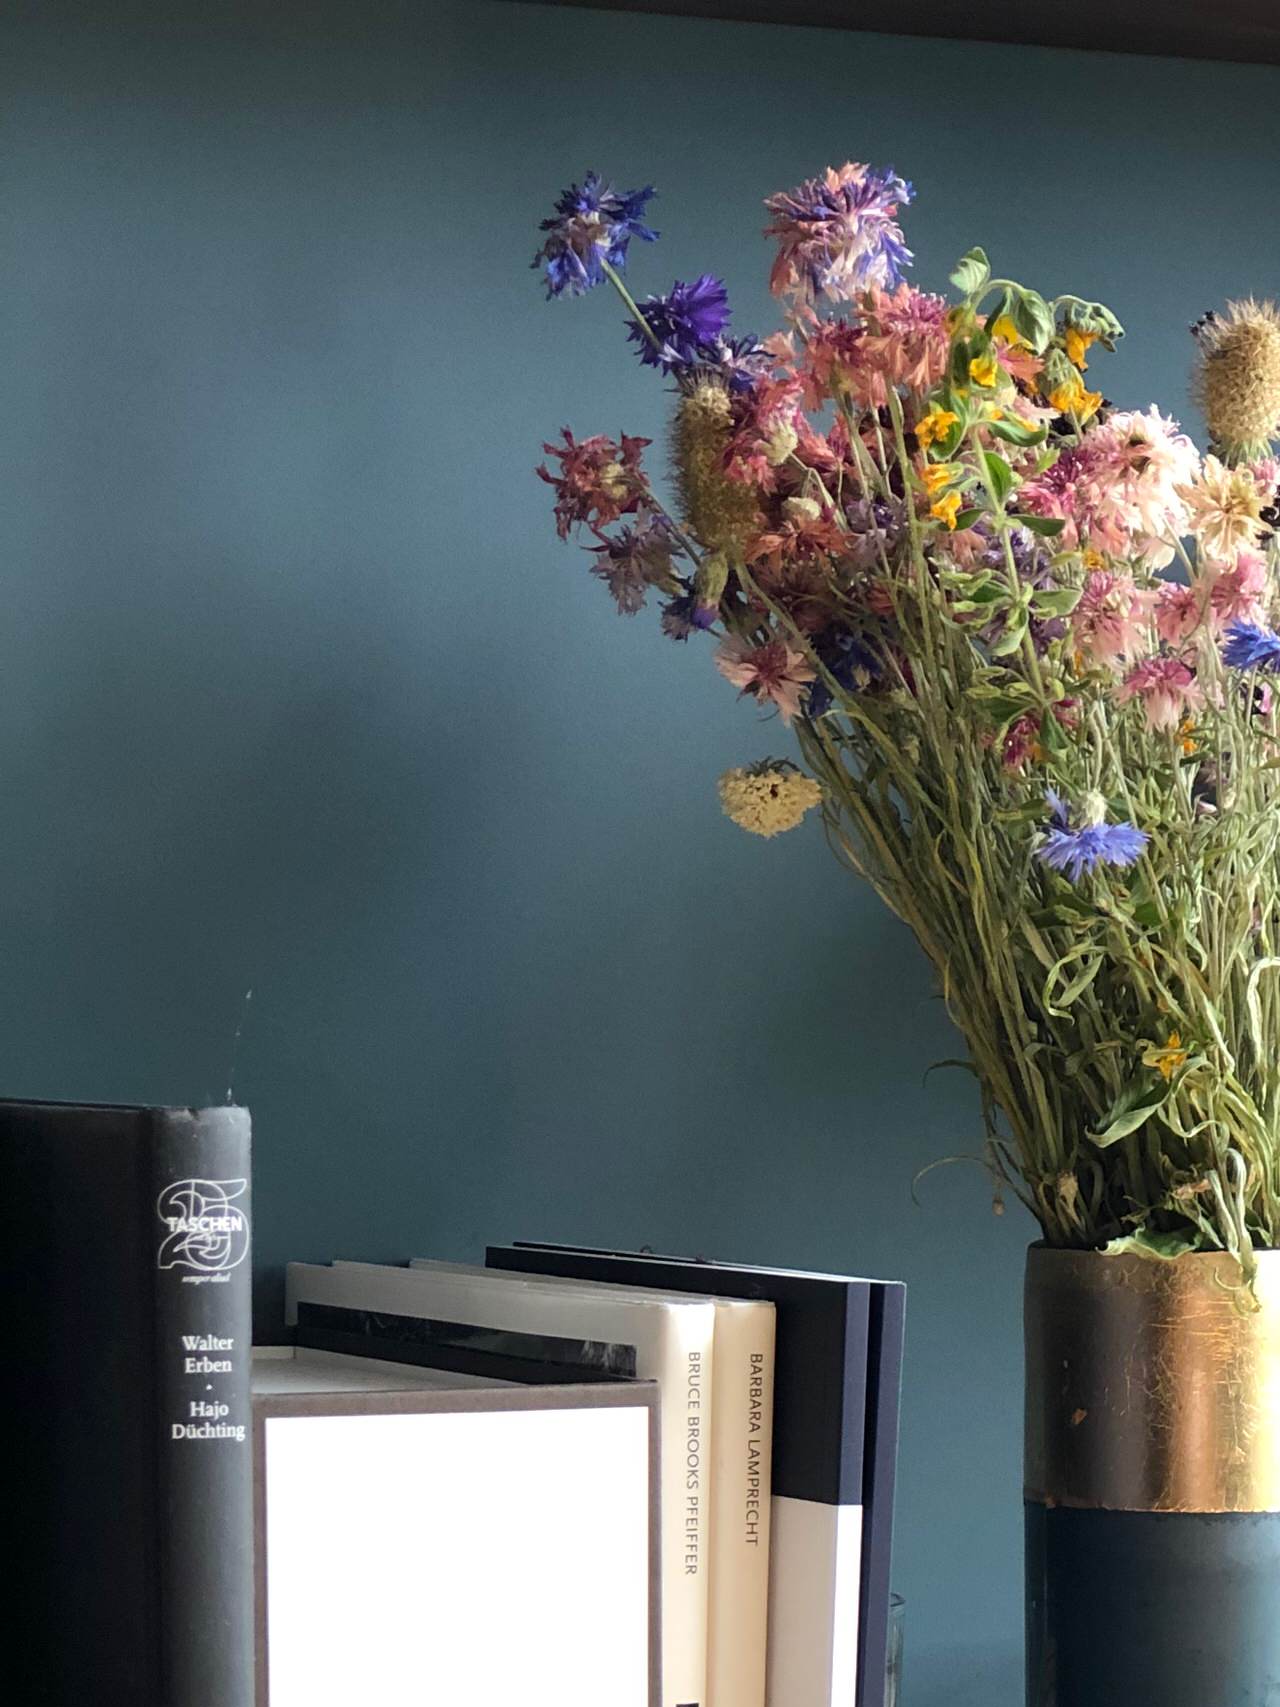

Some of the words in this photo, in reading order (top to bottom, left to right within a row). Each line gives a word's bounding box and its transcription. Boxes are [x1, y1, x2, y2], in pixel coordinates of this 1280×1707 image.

[167, 1216, 242, 1232] TASCHEN
[182, 1335, 234, 1350] Walter
[184, 1357, 232, 1373] Erben
[687, 1351, 701, 1410] BRUCE
[190, 1401, 229, 1418] Hajo
[749, 1353, 763, 1433] BARBARA
[171, 1423, 245, 1441] Düchting
[686, 1416, 700, 1490] BROOKS
[745, 1439, 761, 1546] LAMPRECHT
[684, 1496, 699, 1576] PFEIFFER
